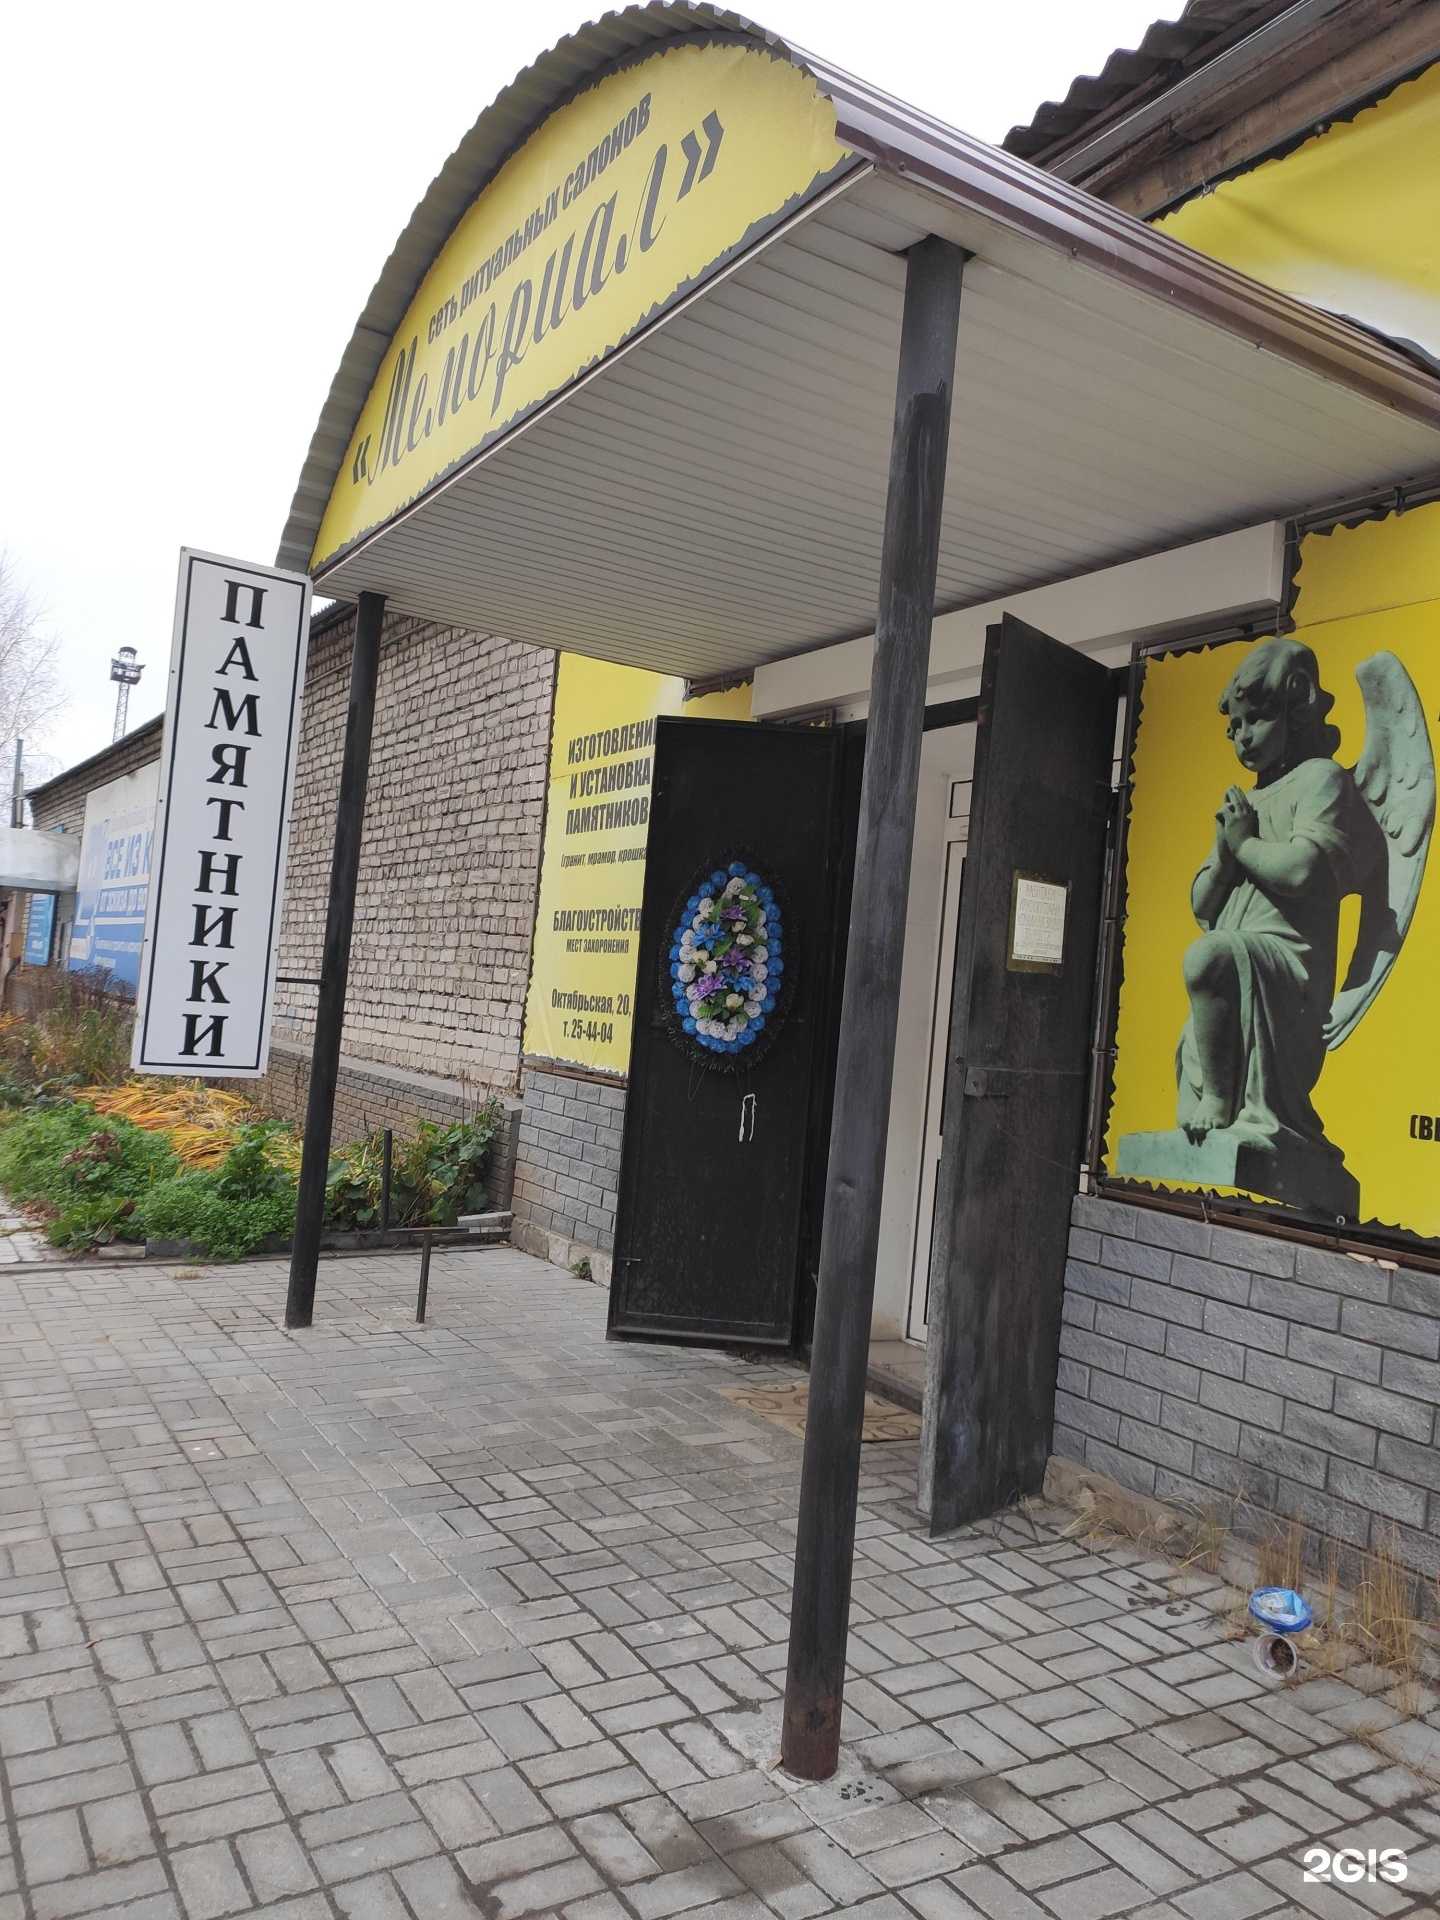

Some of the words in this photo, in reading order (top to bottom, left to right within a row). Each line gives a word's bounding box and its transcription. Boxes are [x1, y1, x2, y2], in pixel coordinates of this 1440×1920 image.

[428, 295, 458, 345] сеть
[460, 186, 561, 317] ритуальных
[562, 92, 652, 210] салонов
[569, 773, 578, 799] И
[579, 757, 651, 798] УСТАНОВКА
[178, 579, 269, 1057] ПАМЯТНИКИ
[566, 796, 649, 835] ПАМЯТНИКОВ
[565, 938, 582, 953] МЕСТ
[583, 938, 629, 953] ЗАХОРОНЕНИЯ
[551, 988, 614, 1017] Октябрьская,
[616, 994, 632, 1017] 20,
[571, 1018, 613, 1044] 25-44-04
